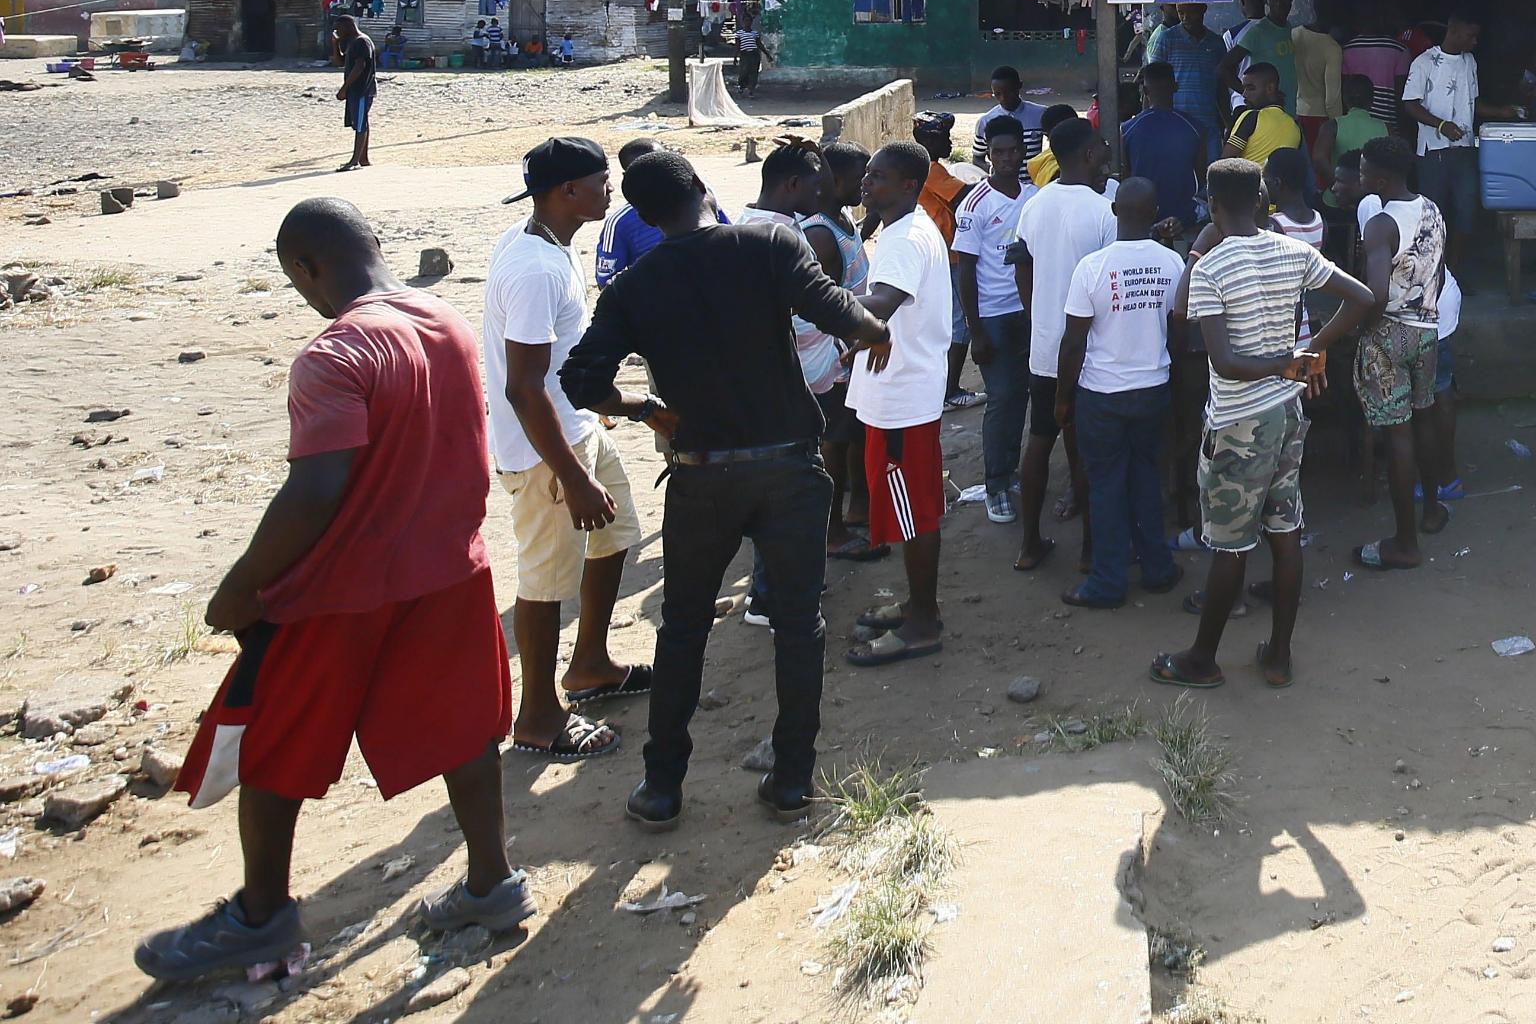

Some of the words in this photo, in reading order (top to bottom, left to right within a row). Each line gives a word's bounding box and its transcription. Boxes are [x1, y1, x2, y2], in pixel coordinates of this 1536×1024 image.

[1122, 268, 1143, 276] WORLD
[1124, 278, 1155, 287] EUROPEAN
[1125, 290, 1149, 299] AFRICAN
[1123, 303, 1137, 312] HEAD
